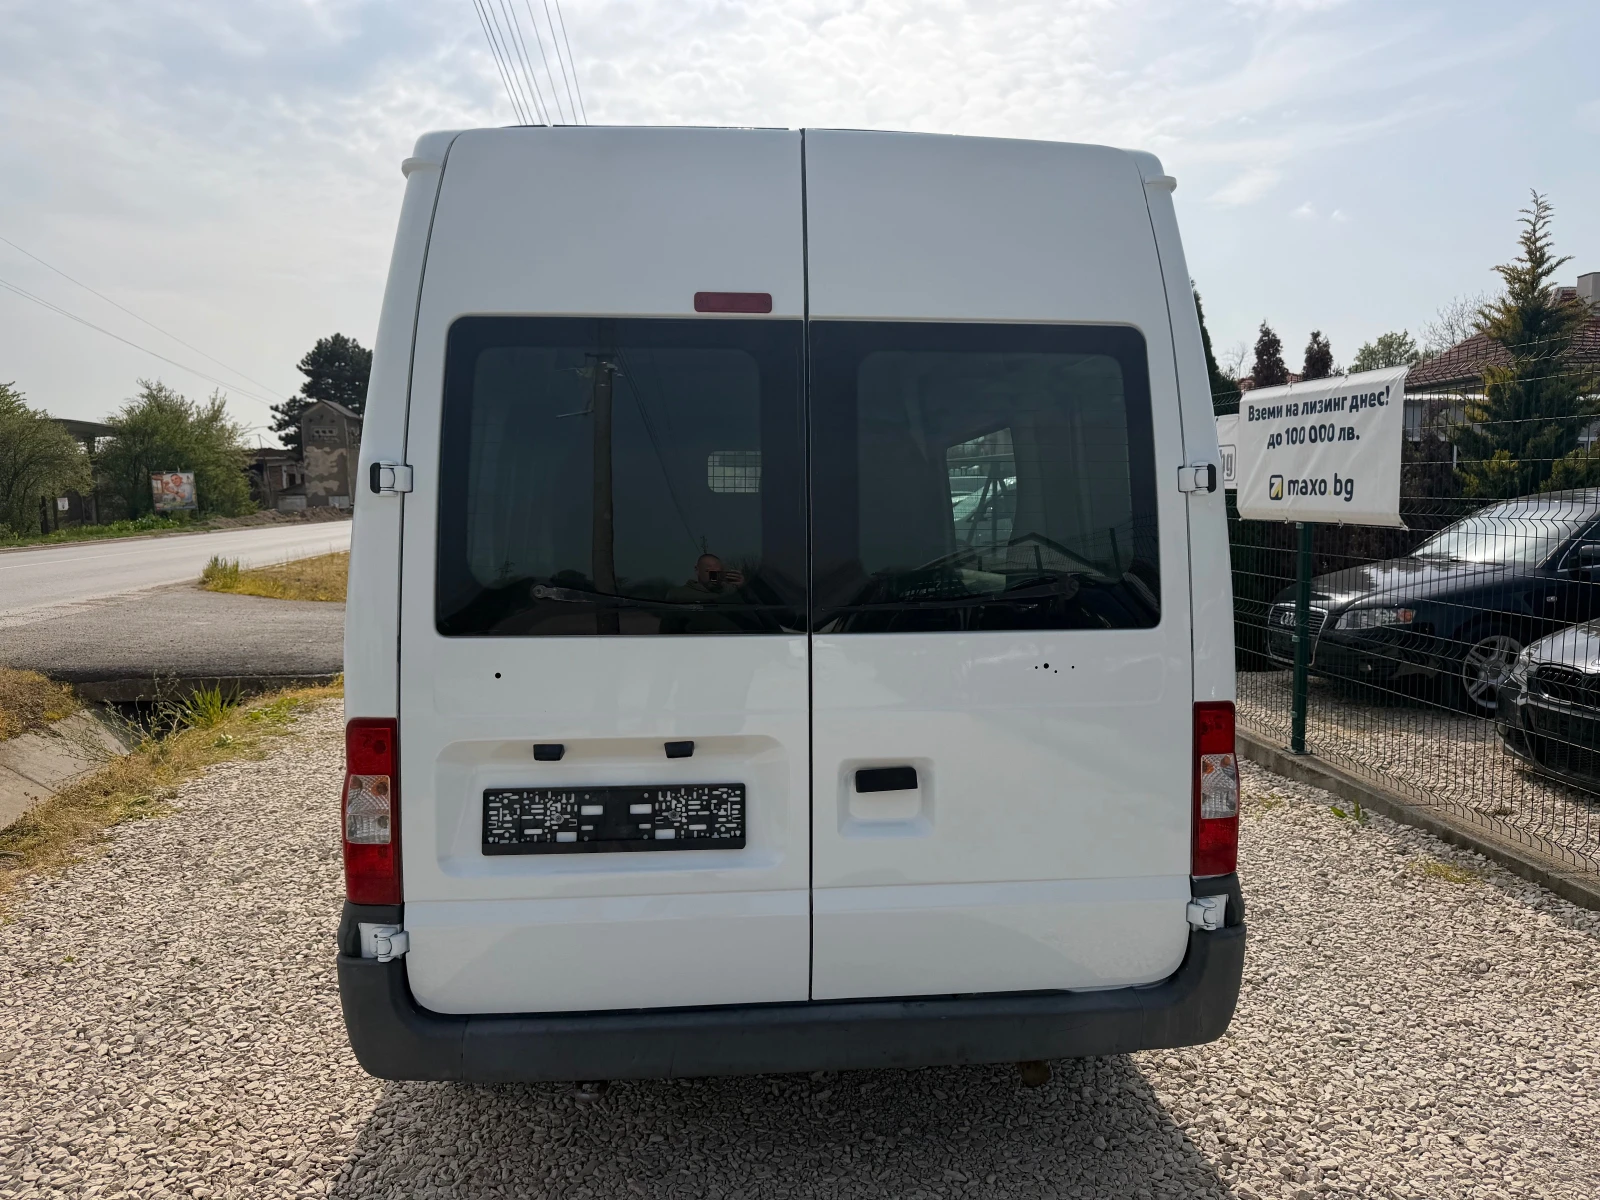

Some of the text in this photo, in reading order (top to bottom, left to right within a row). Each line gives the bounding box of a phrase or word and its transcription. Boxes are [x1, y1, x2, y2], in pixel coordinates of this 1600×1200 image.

[1248, 385, 1390, 422] Вземи на лизинг днес!
[1267, 423, 1361, 450] до 100 000 лв.
[1287, 473, 1354, 502] maxo.bg
